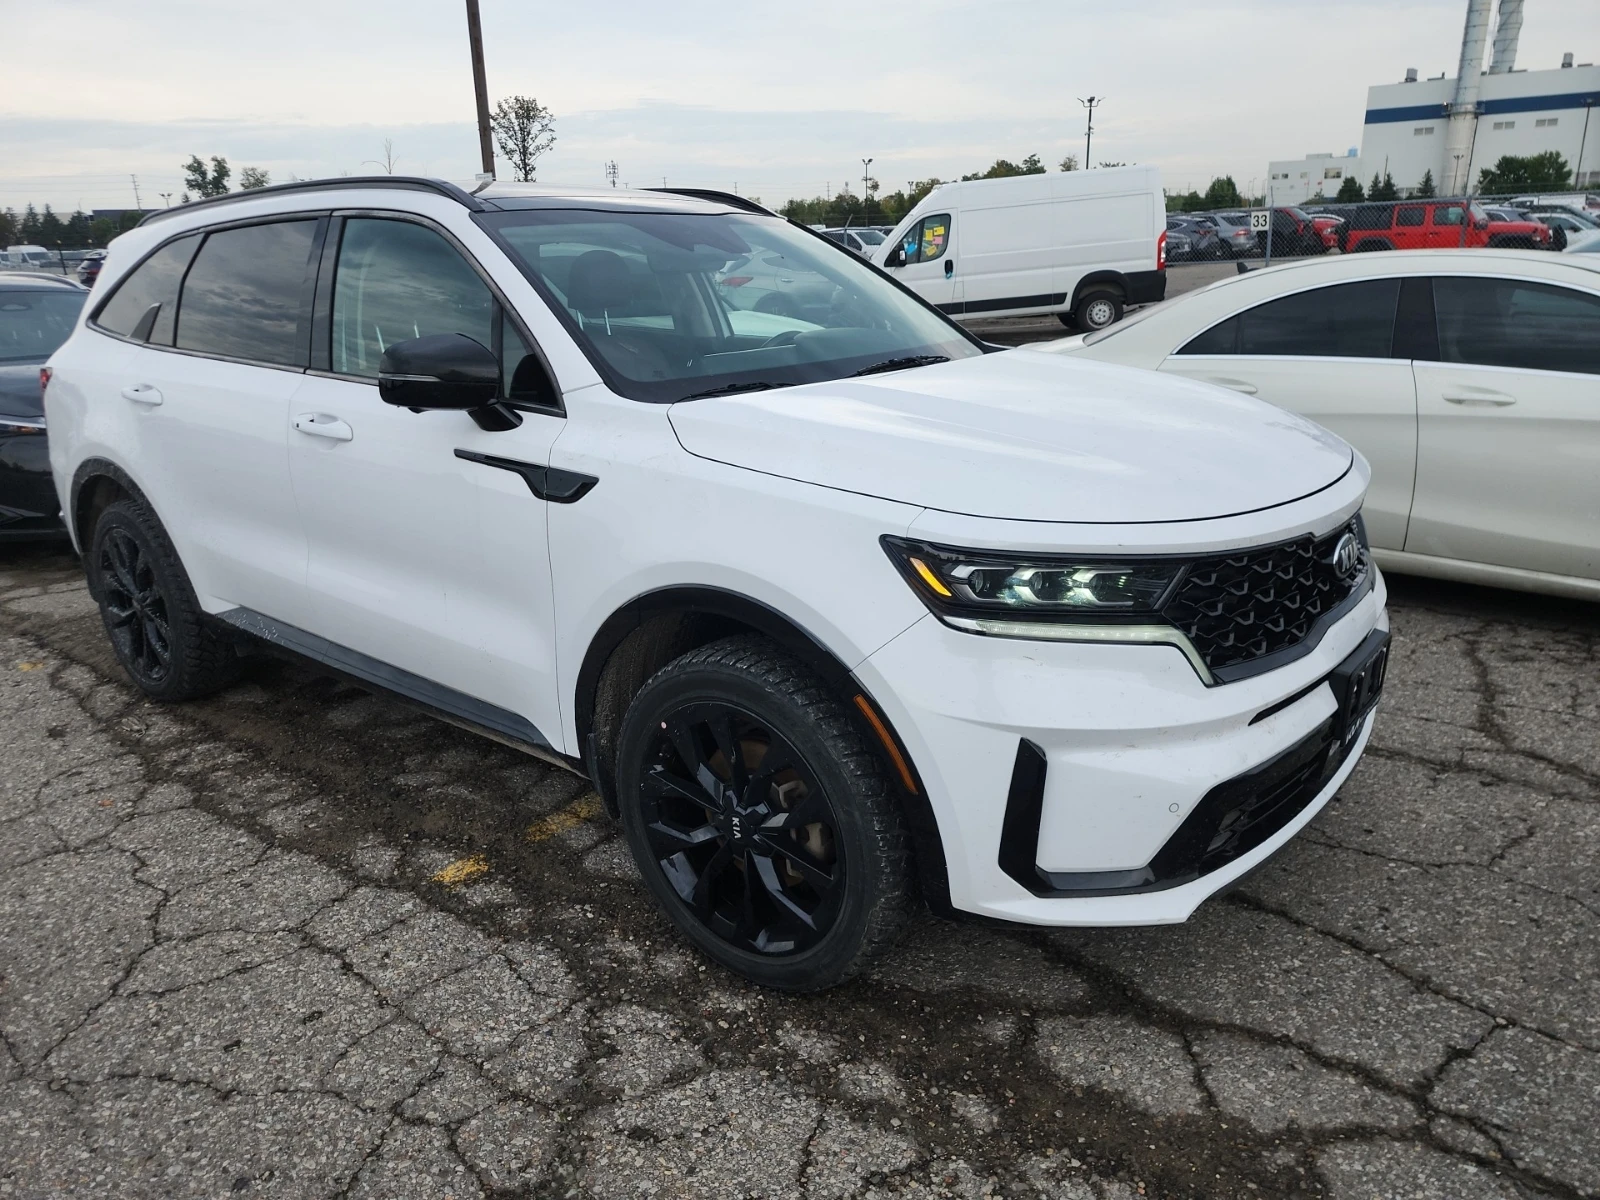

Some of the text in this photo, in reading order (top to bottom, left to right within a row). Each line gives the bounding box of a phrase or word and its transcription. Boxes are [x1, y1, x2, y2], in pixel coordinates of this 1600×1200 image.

[1253, 214, 1268, 228] 33
[1340, 541, 1358, 572] KIA
[732, 816, 742, 839] KIA
